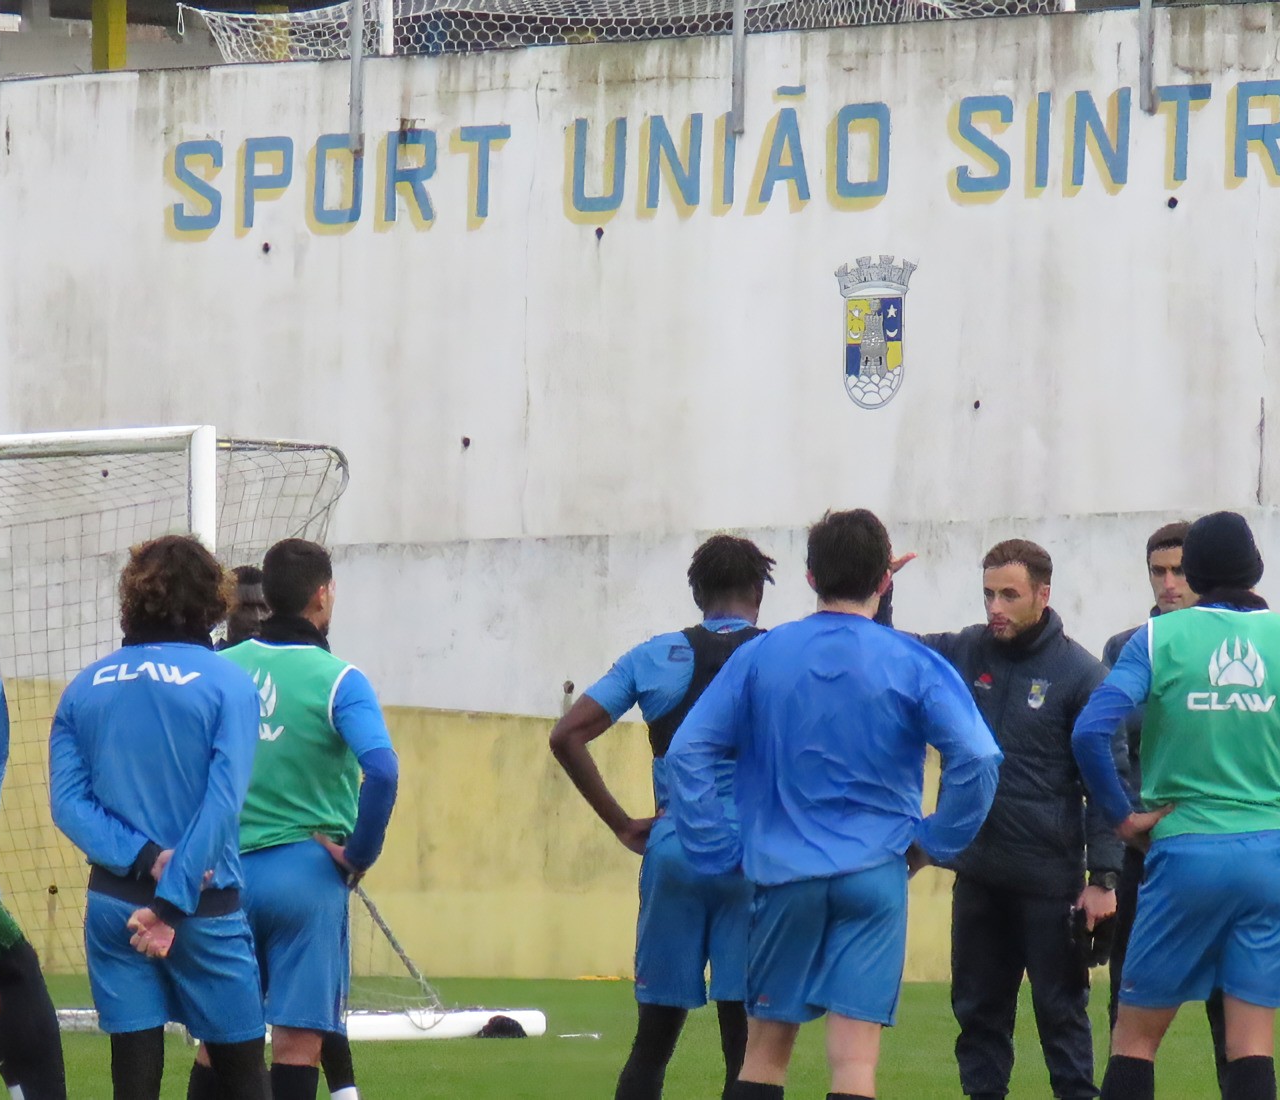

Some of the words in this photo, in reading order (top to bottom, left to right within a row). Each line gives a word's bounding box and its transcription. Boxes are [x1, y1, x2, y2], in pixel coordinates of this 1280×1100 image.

[163, 124, 511, 241] SPORT
[564, 84, 892, 230] UNIÃO
[92, 661, 201, 686] CLAW
[1186, 691, 1277, 713] CLAW
